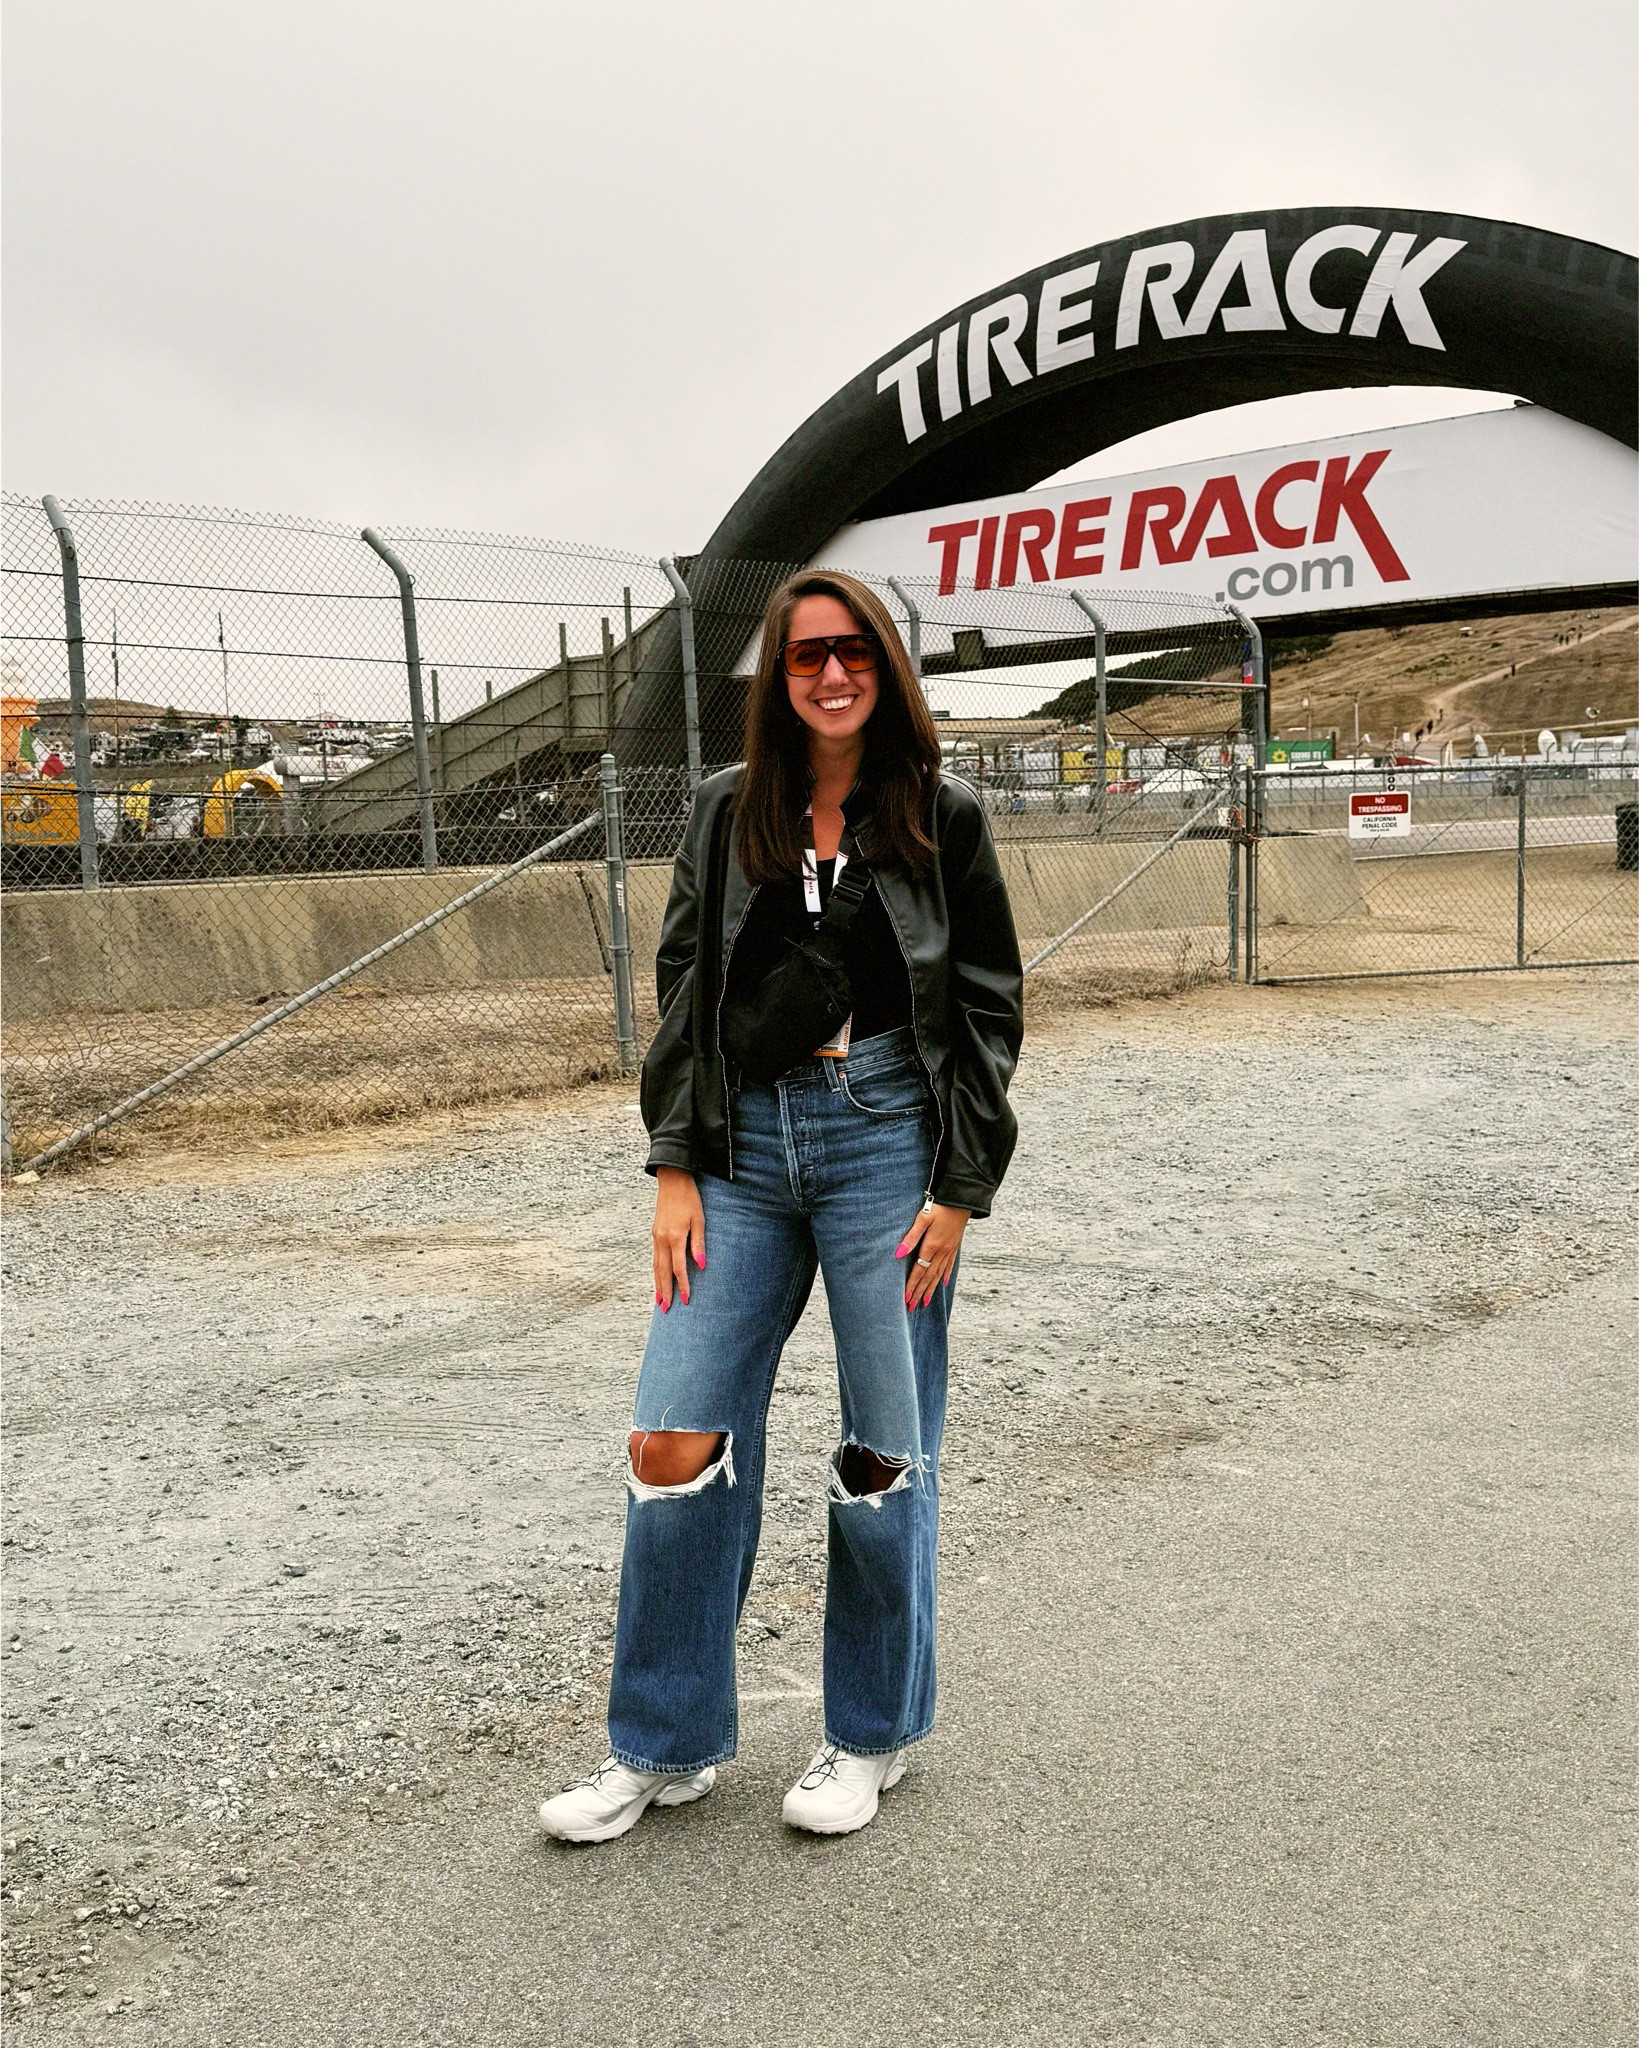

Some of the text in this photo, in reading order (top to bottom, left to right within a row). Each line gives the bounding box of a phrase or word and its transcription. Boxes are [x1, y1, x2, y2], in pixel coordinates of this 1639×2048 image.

[876, 224, 1468, 445] TIRE RACK
[927, 449, 1411, 596] TIRE RACK
[1215, 554, 1355, 602] .com
[1374, 796, 1386, 804] NO
[1357, 805, 1403, 813] TRESPASSING
[1362, 815, 1397, 823] CALIFORNIA
[1381, 821, 1398, 829] CODE
